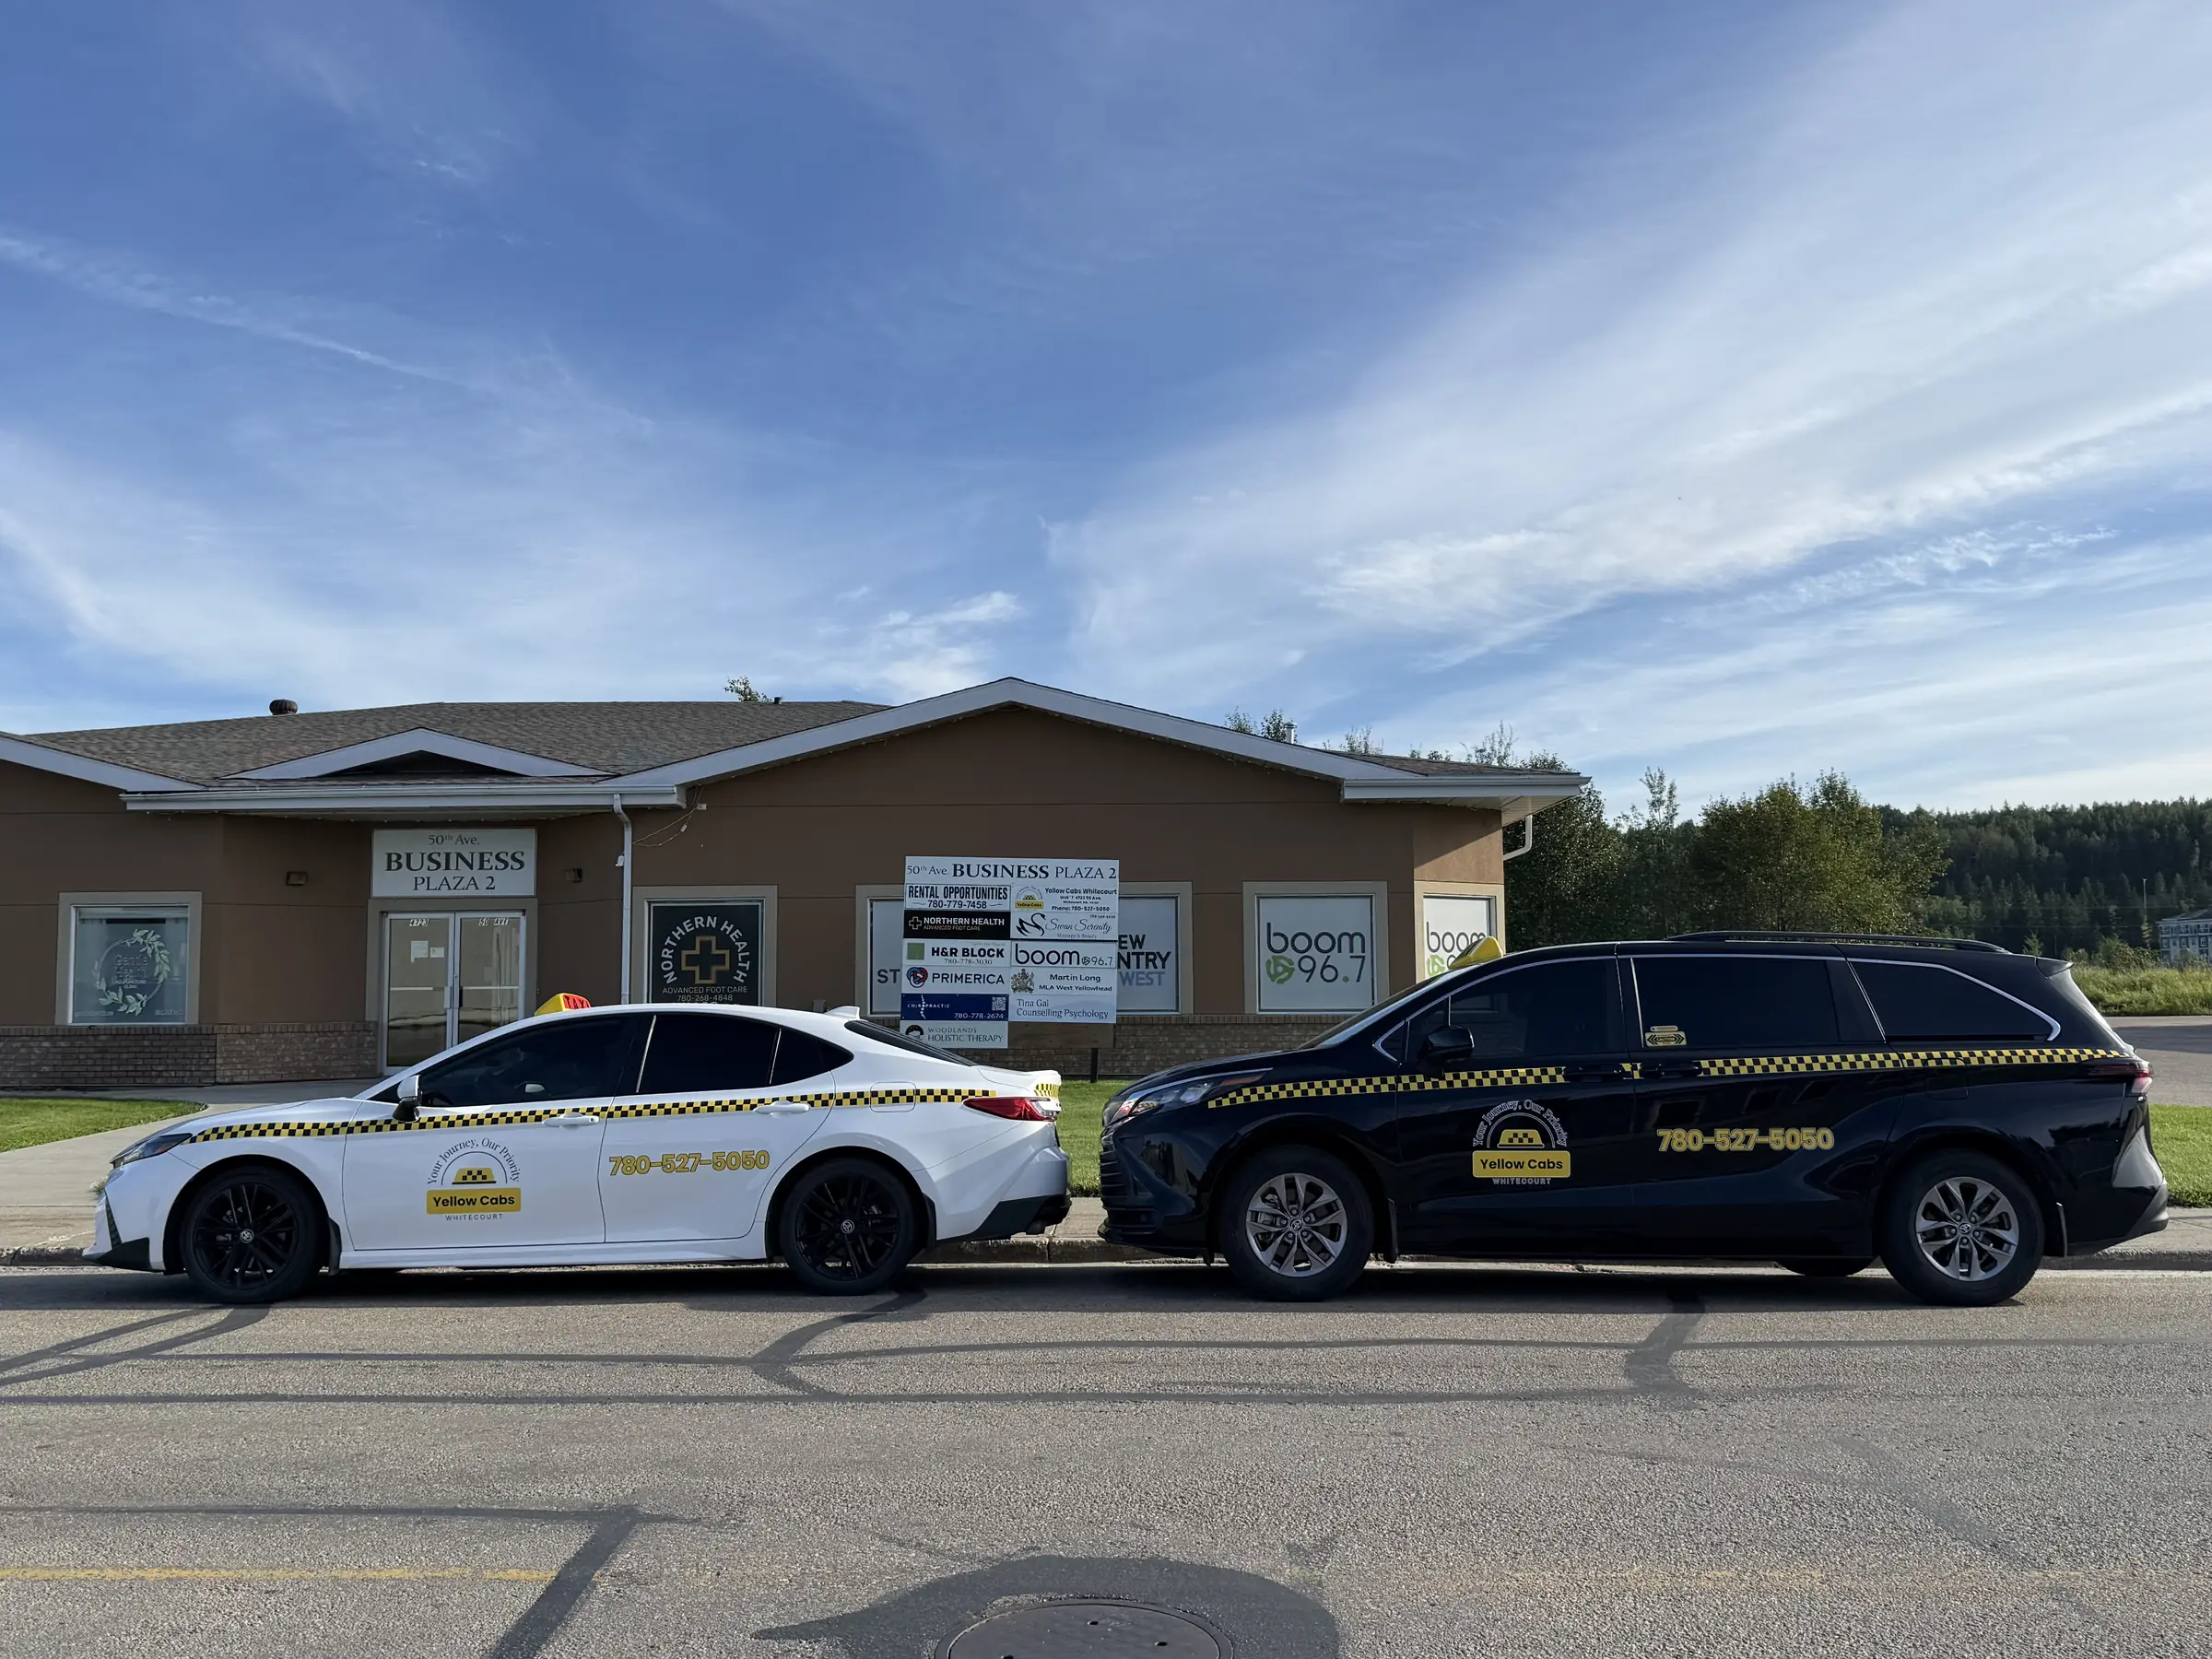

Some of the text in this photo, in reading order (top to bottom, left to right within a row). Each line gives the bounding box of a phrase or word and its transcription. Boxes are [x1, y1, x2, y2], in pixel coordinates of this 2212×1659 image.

[429, 834, 480, 845] 50th Ave.
[385, 851, 525, 871] BUSINESS
[907, 863, 1117, 879] 50th Ave. BUSINESS PLAZA 2
[413, 876, 496, 890] PLAZA 2
[908, 886, 939, 899] RENTAL
[943, 886, 1008, 900] OPPORTUNITIES
[927, 900, 987, 909] 780-779-7458
[1045, 918, 1073, 931] Swan
[1118, 935, 1146, 949] EW
[1266, 922, 1365, 954] boom
[661, 916, 750, 983] NORTHERN HEALTH
[931, 947, 1005, 958] H&R BLOCK
[1015, 943, 1113, 966] boom 96.7
[1117, 951, 1171, 969] NTRY
[877, 969, 901, 983] ST
[1298, 955, 1366, 983] 96.7
[932, 972, 1005, 984] PRIMERICA
[1079, 974, 1100, 982] Long
[563, 994, 590, 1010] TAXI
[1017, 998, 1034, 1006] Tina
[1017, 1008, 1109, 1019] Counselling Psychology
[967, 1034, 1003, 1042] THERAPY
[1472, 1121, 1488, 1147] Your
[1523, 1099, 1545, 1114] Our
[1656, 1127, 1835, 1152] 780-527-5050
[428, 1159, 443, 1184] Your
[481, 1136, 501, 1150] Our
[499, 1147, 522, 1182] Priority
[609, 1149, 771, 1176] 780-527-5050
[1480, 1159, 1563, 1169] Yellow Cabs
[433, 1194, 515, 1207] Yellow Cabs
[445, 1213, 503, 1221] WHITECOURT
